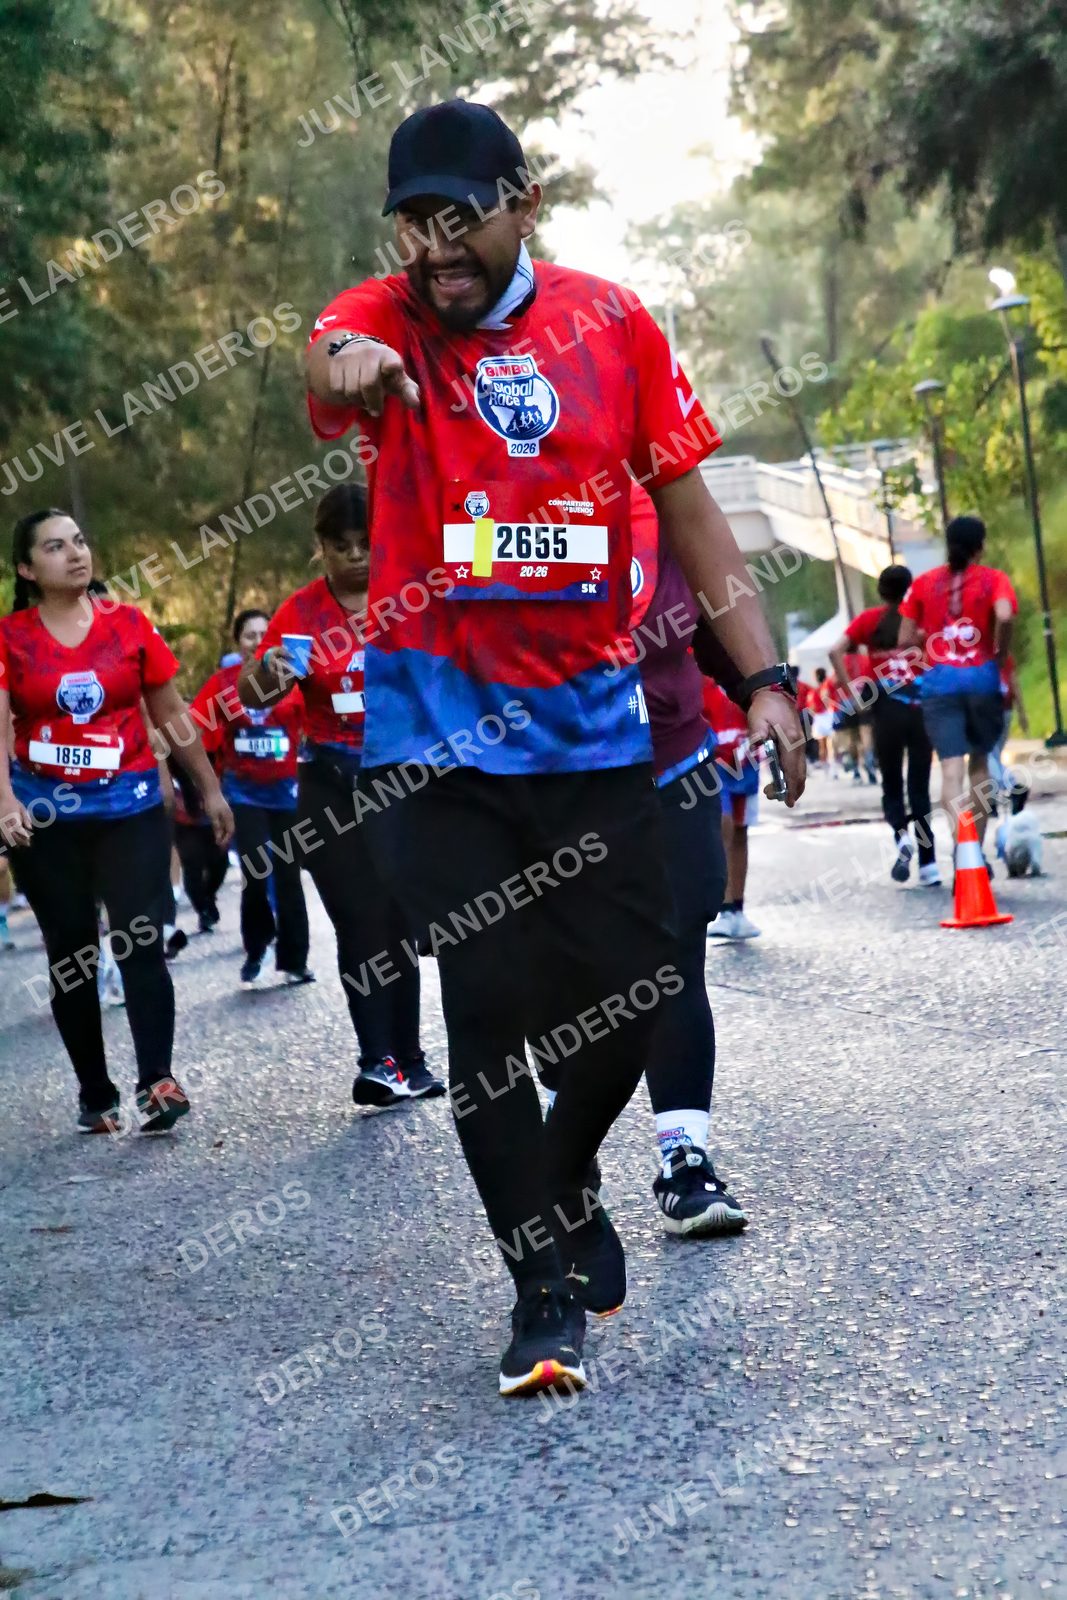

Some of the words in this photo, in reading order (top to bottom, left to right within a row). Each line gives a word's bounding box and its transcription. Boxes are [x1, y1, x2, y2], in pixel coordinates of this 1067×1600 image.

[484, 364, 531, 377] BIMBO
[493, 378, 533, 397] Global
[488, 392, 521, 406] Race
[510, 442, 537, 455] 2026
[548, 499, 595, 508] COMPARTIMOS
[496, 525, 568, 560] 2655
[581, 583, 597, 594] 5K
[55, 746, 92, 767] 1858
